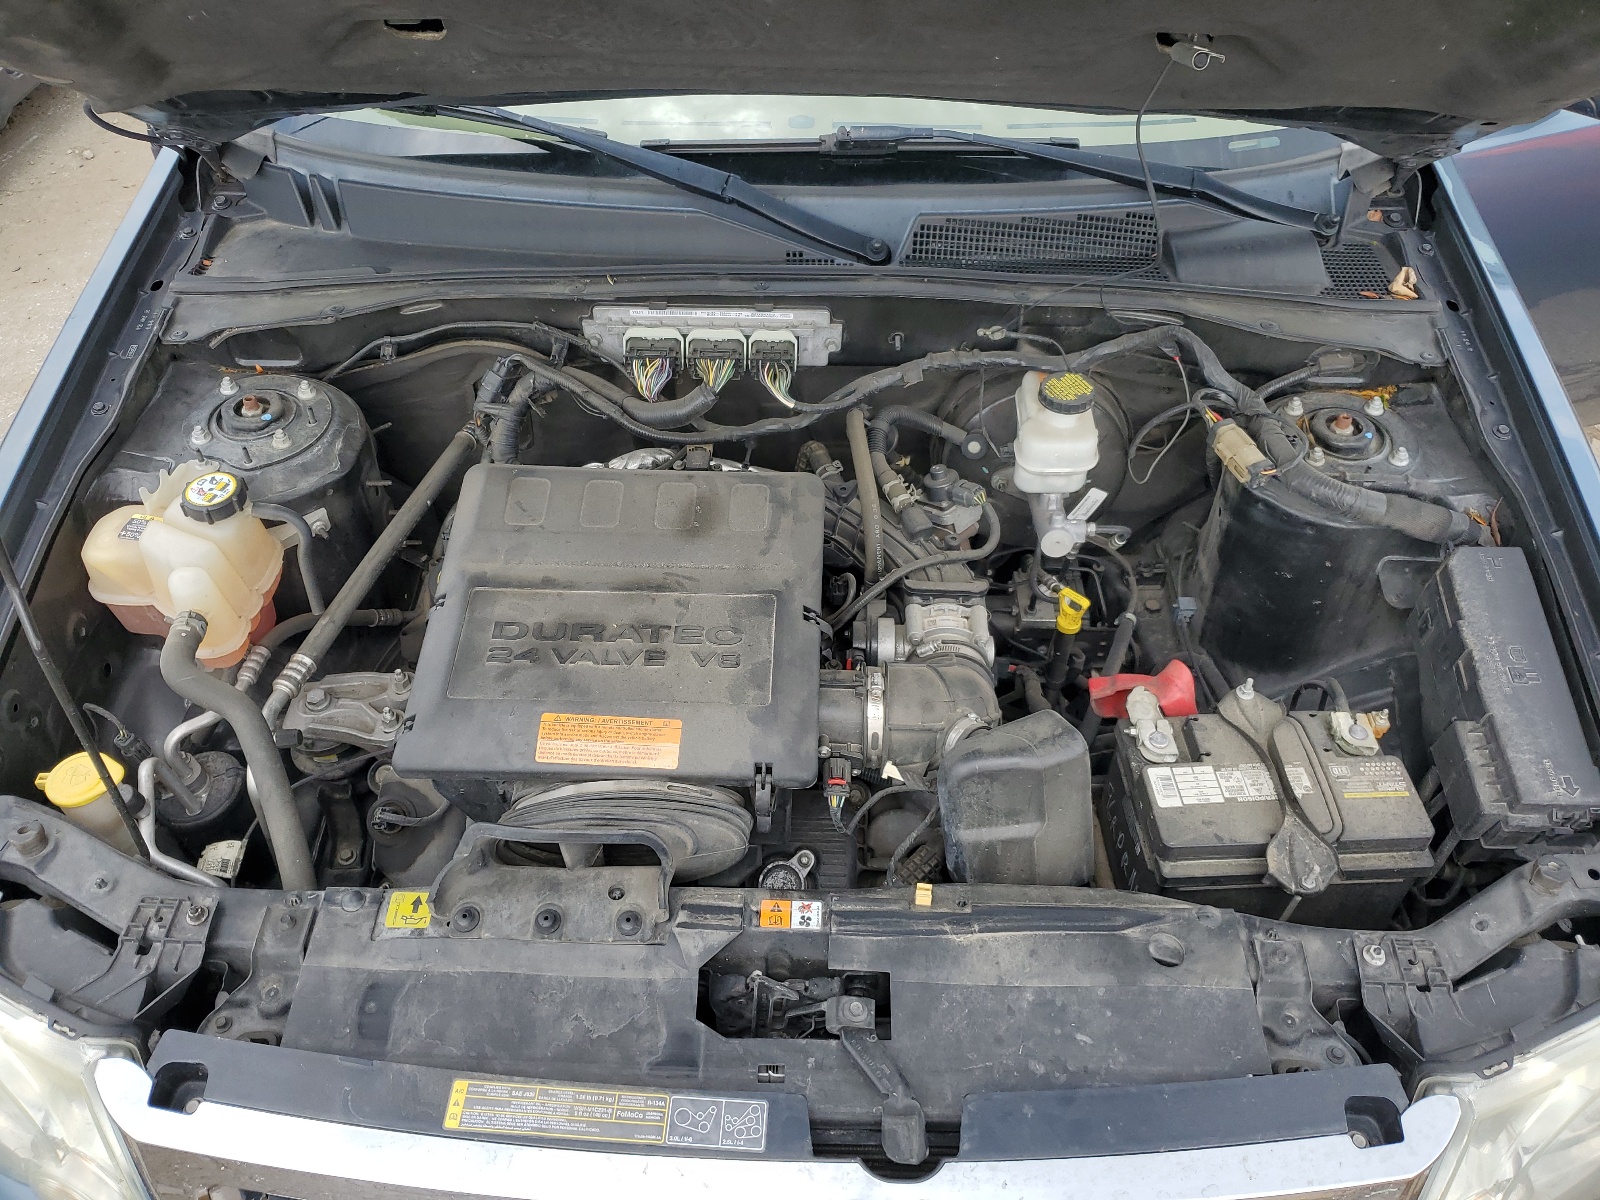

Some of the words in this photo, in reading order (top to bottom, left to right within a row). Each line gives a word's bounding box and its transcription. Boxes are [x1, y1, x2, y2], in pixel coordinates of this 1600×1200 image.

[491, 620, 744, 646] DURATEC
[486, 646, 540, 664] 24
[550, 648, 667, 667] VALVE
[690, 650, 742, 669] V6
[602, 718, 654, 726] AVERTISSEMENT
[617, 1110, 643, 1118] FoMoCo
